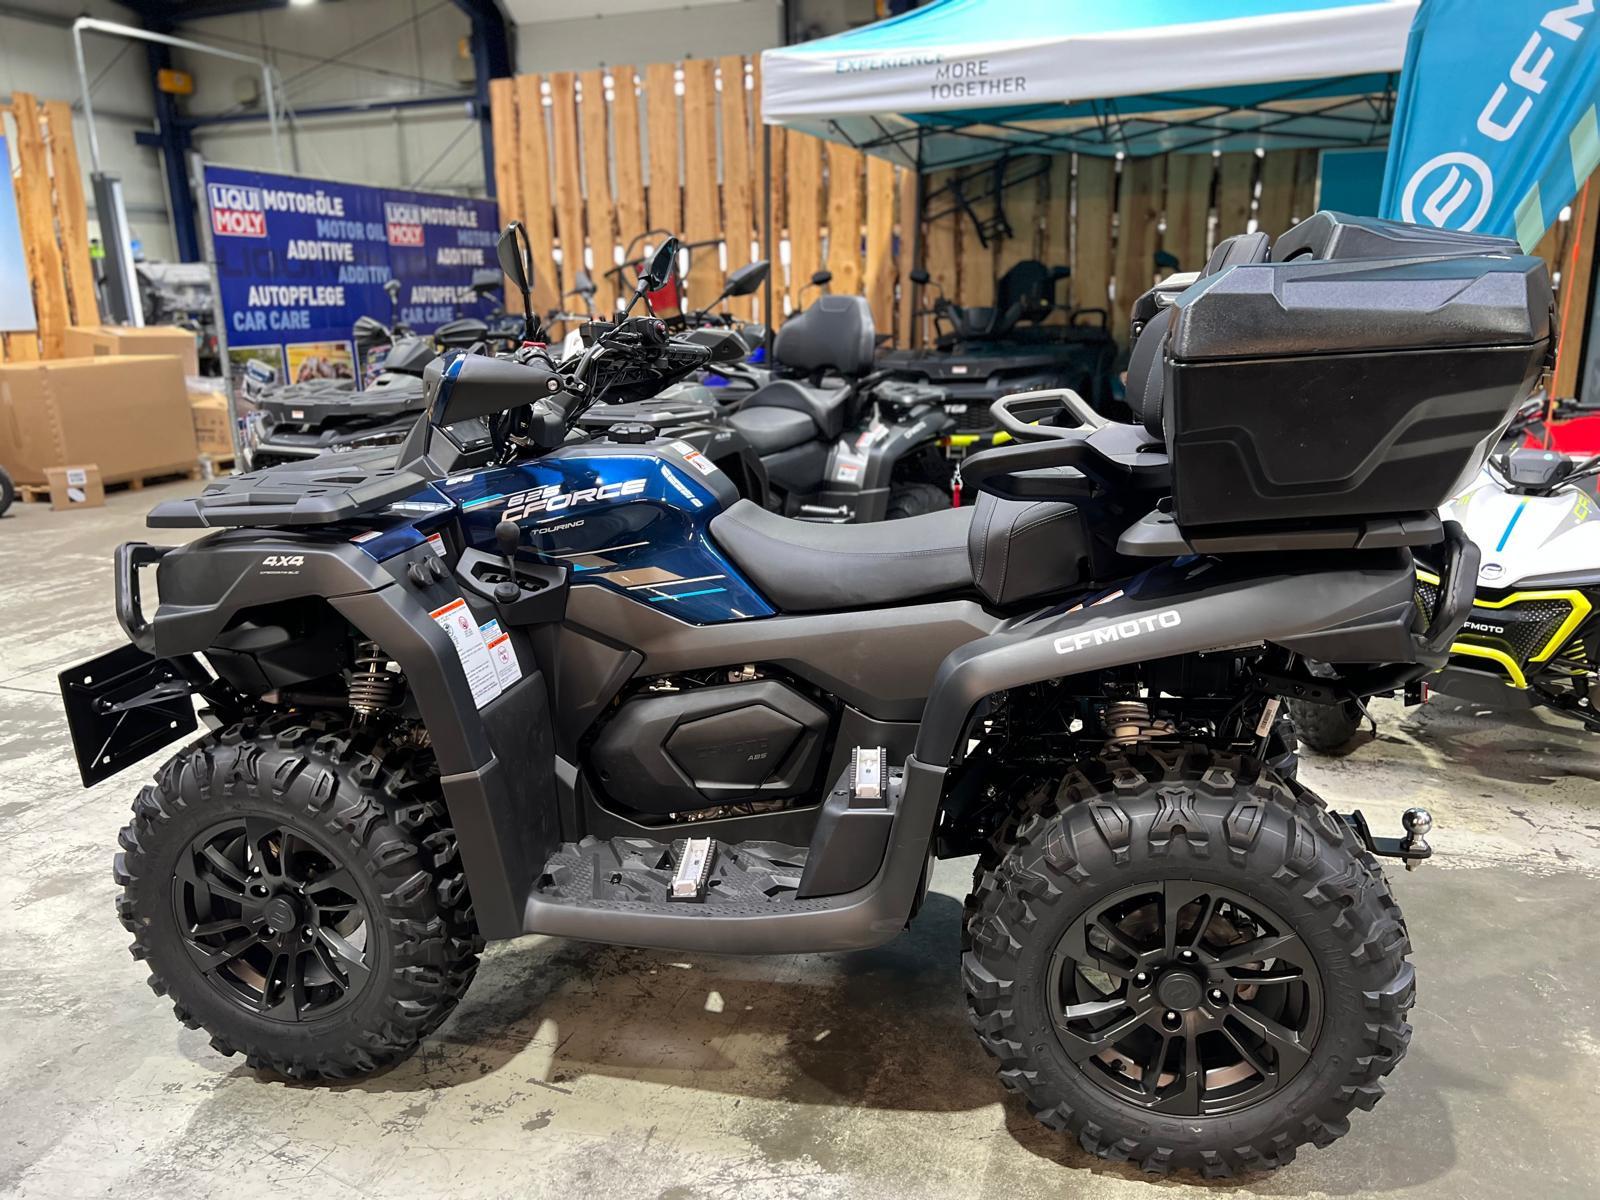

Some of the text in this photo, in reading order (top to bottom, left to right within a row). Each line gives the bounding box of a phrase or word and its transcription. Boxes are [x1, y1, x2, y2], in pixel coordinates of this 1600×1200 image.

[936, 60, 989, 81] MORE
[931, 77, 1026, 99] TOGETHER
[211, 187, 261, 212] LIQUI
[262, 189, 344, 216] MOTORÖLE
[214, 209, 264, 233] MOLY
[386, 204, 420, 224] LIQUI
[316, 218, 387, 241] MOTOR OIL
[389, 224, 422, 246] MOLY
[287, 239, 354, 262] ADDITIVE
[437, 247, 484, 266] ADDITIVE
[248, 285, 346, 307] AUTOPFLEGE
[233, 310, 310, 332] CAR CARE
[400, 306, 454, 324] CAR CARE
[502, 479, 647, 521] CFORCE
[507, 485, 561, 508] 625
[531, 519, 585, 536] TOURING
[1053, 609, 1182, 655] CFMOTO
[1461, 621, 1504, 634] FMOTO
[747, 752, 769, 762] ABS
